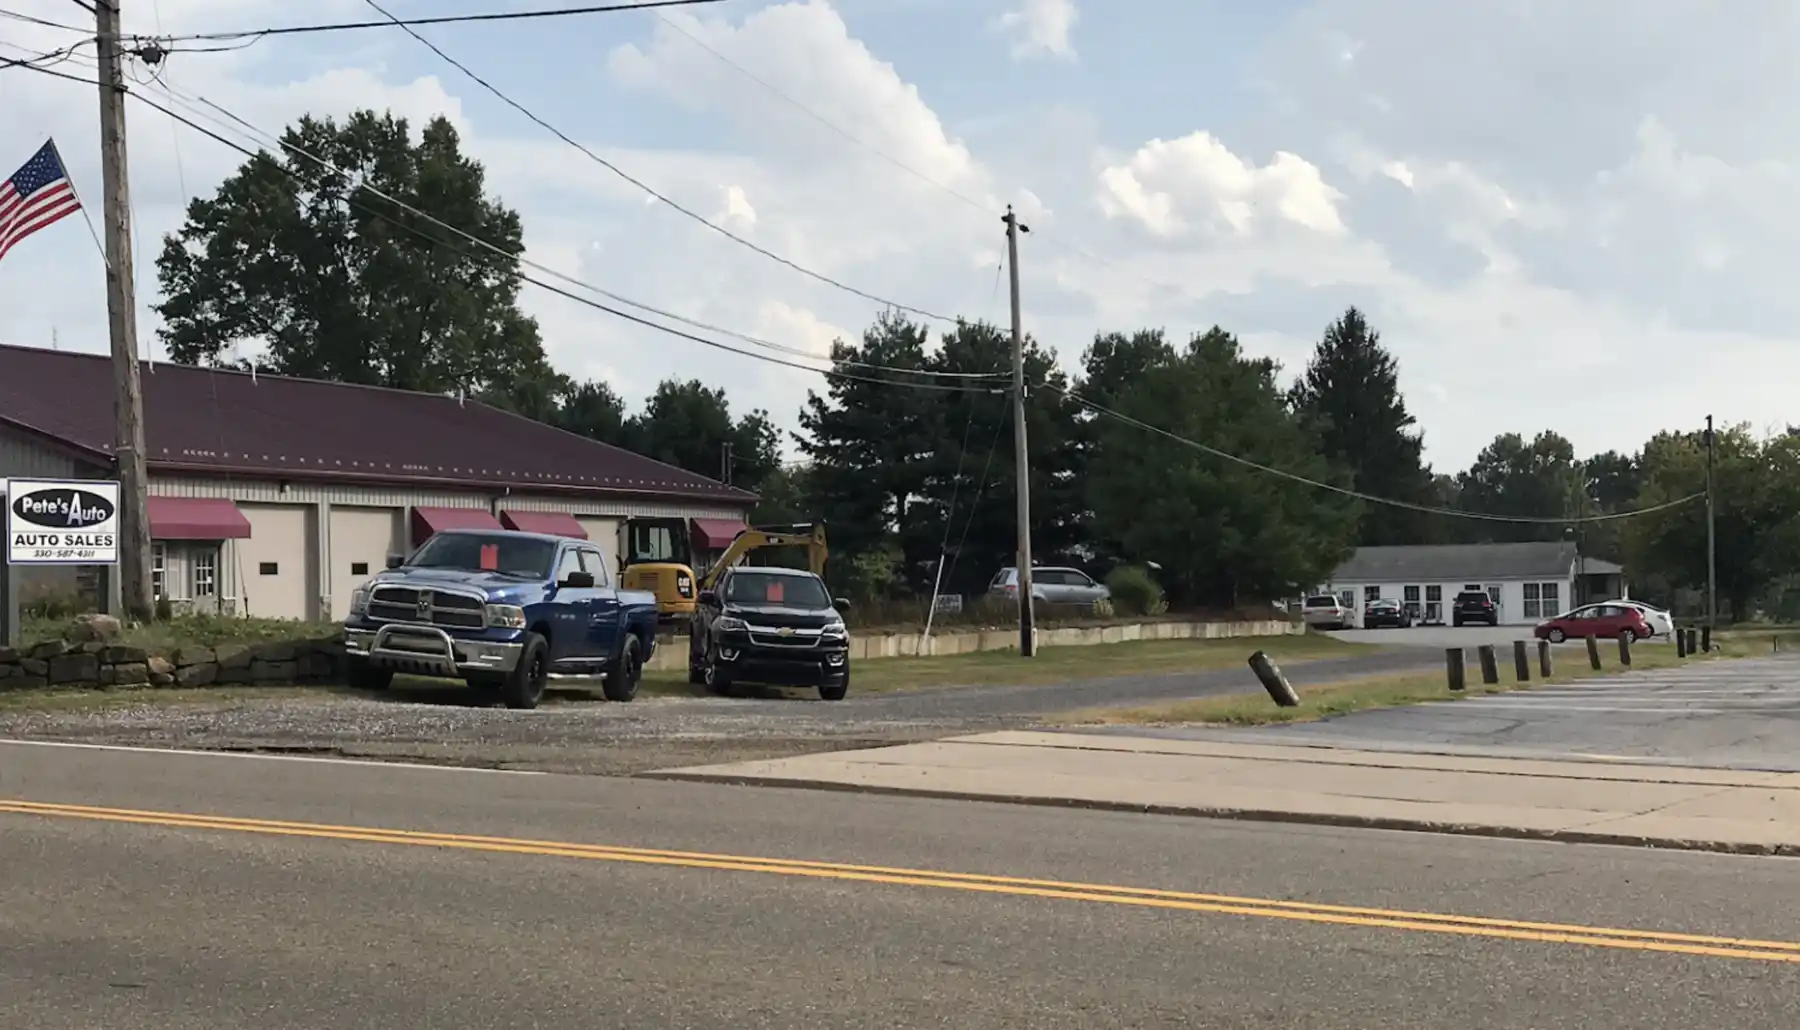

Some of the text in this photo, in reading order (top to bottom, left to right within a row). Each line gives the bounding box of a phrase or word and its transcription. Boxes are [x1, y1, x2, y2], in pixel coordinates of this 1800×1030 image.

[22, 492, 106, 525] Pete's Auto
[15, 534, 113, 546] AUTO SALES
